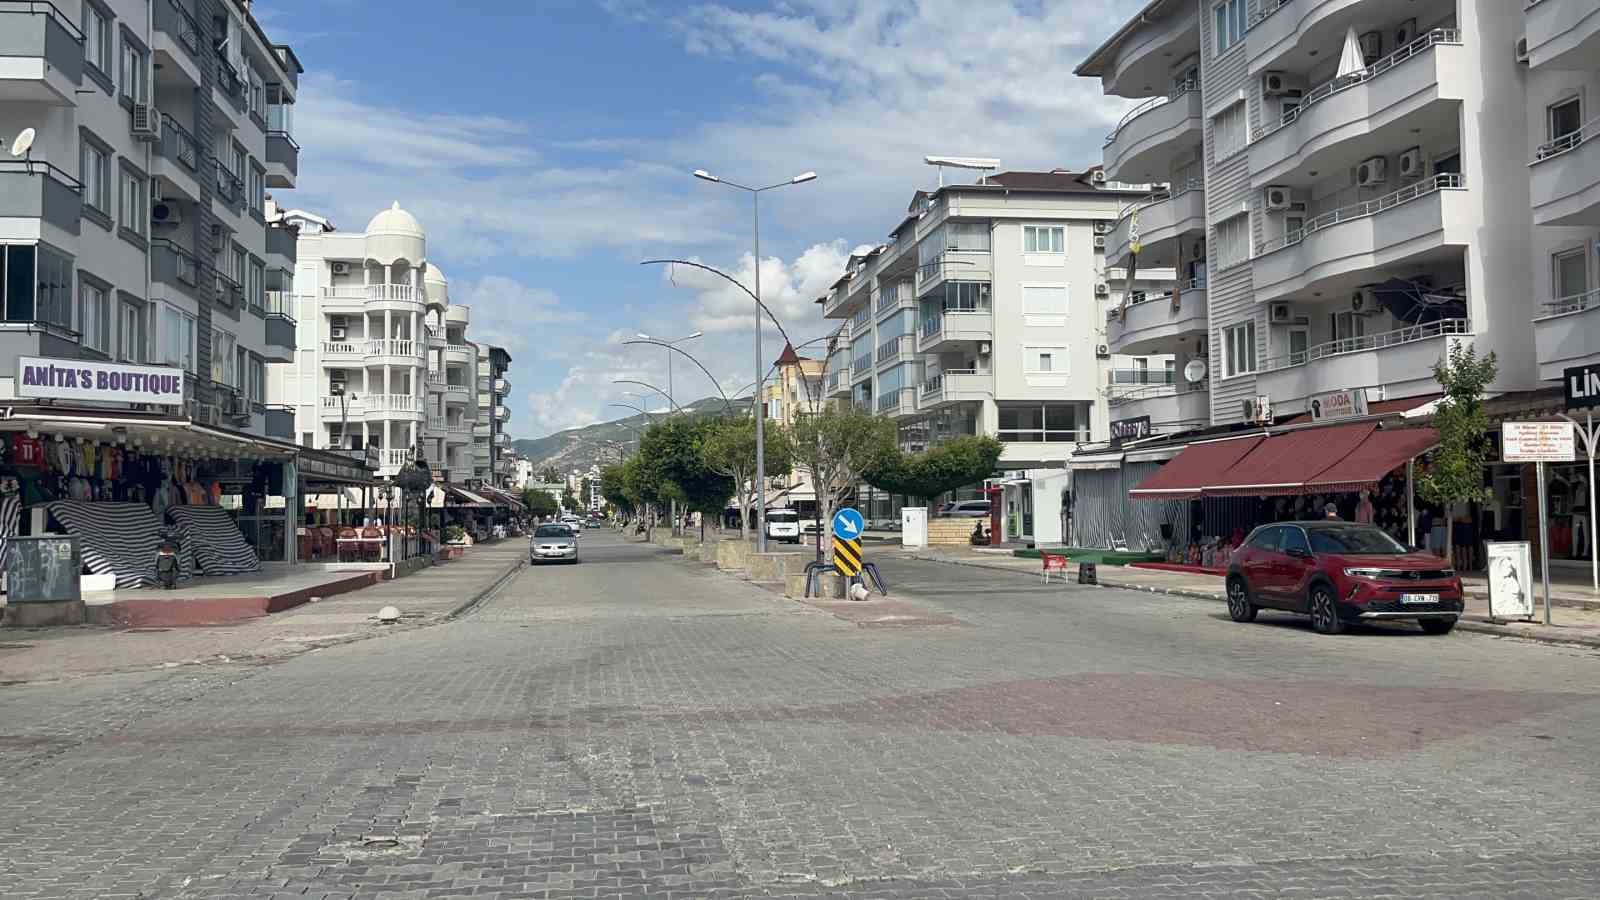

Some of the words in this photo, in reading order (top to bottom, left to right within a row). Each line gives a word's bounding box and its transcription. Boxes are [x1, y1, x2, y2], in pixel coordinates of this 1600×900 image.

[23, 364, 93, 389] ANİTA'S
[97, 371, 180, 395] BOUTIQUE
[22, 444, 33, 461] 11
